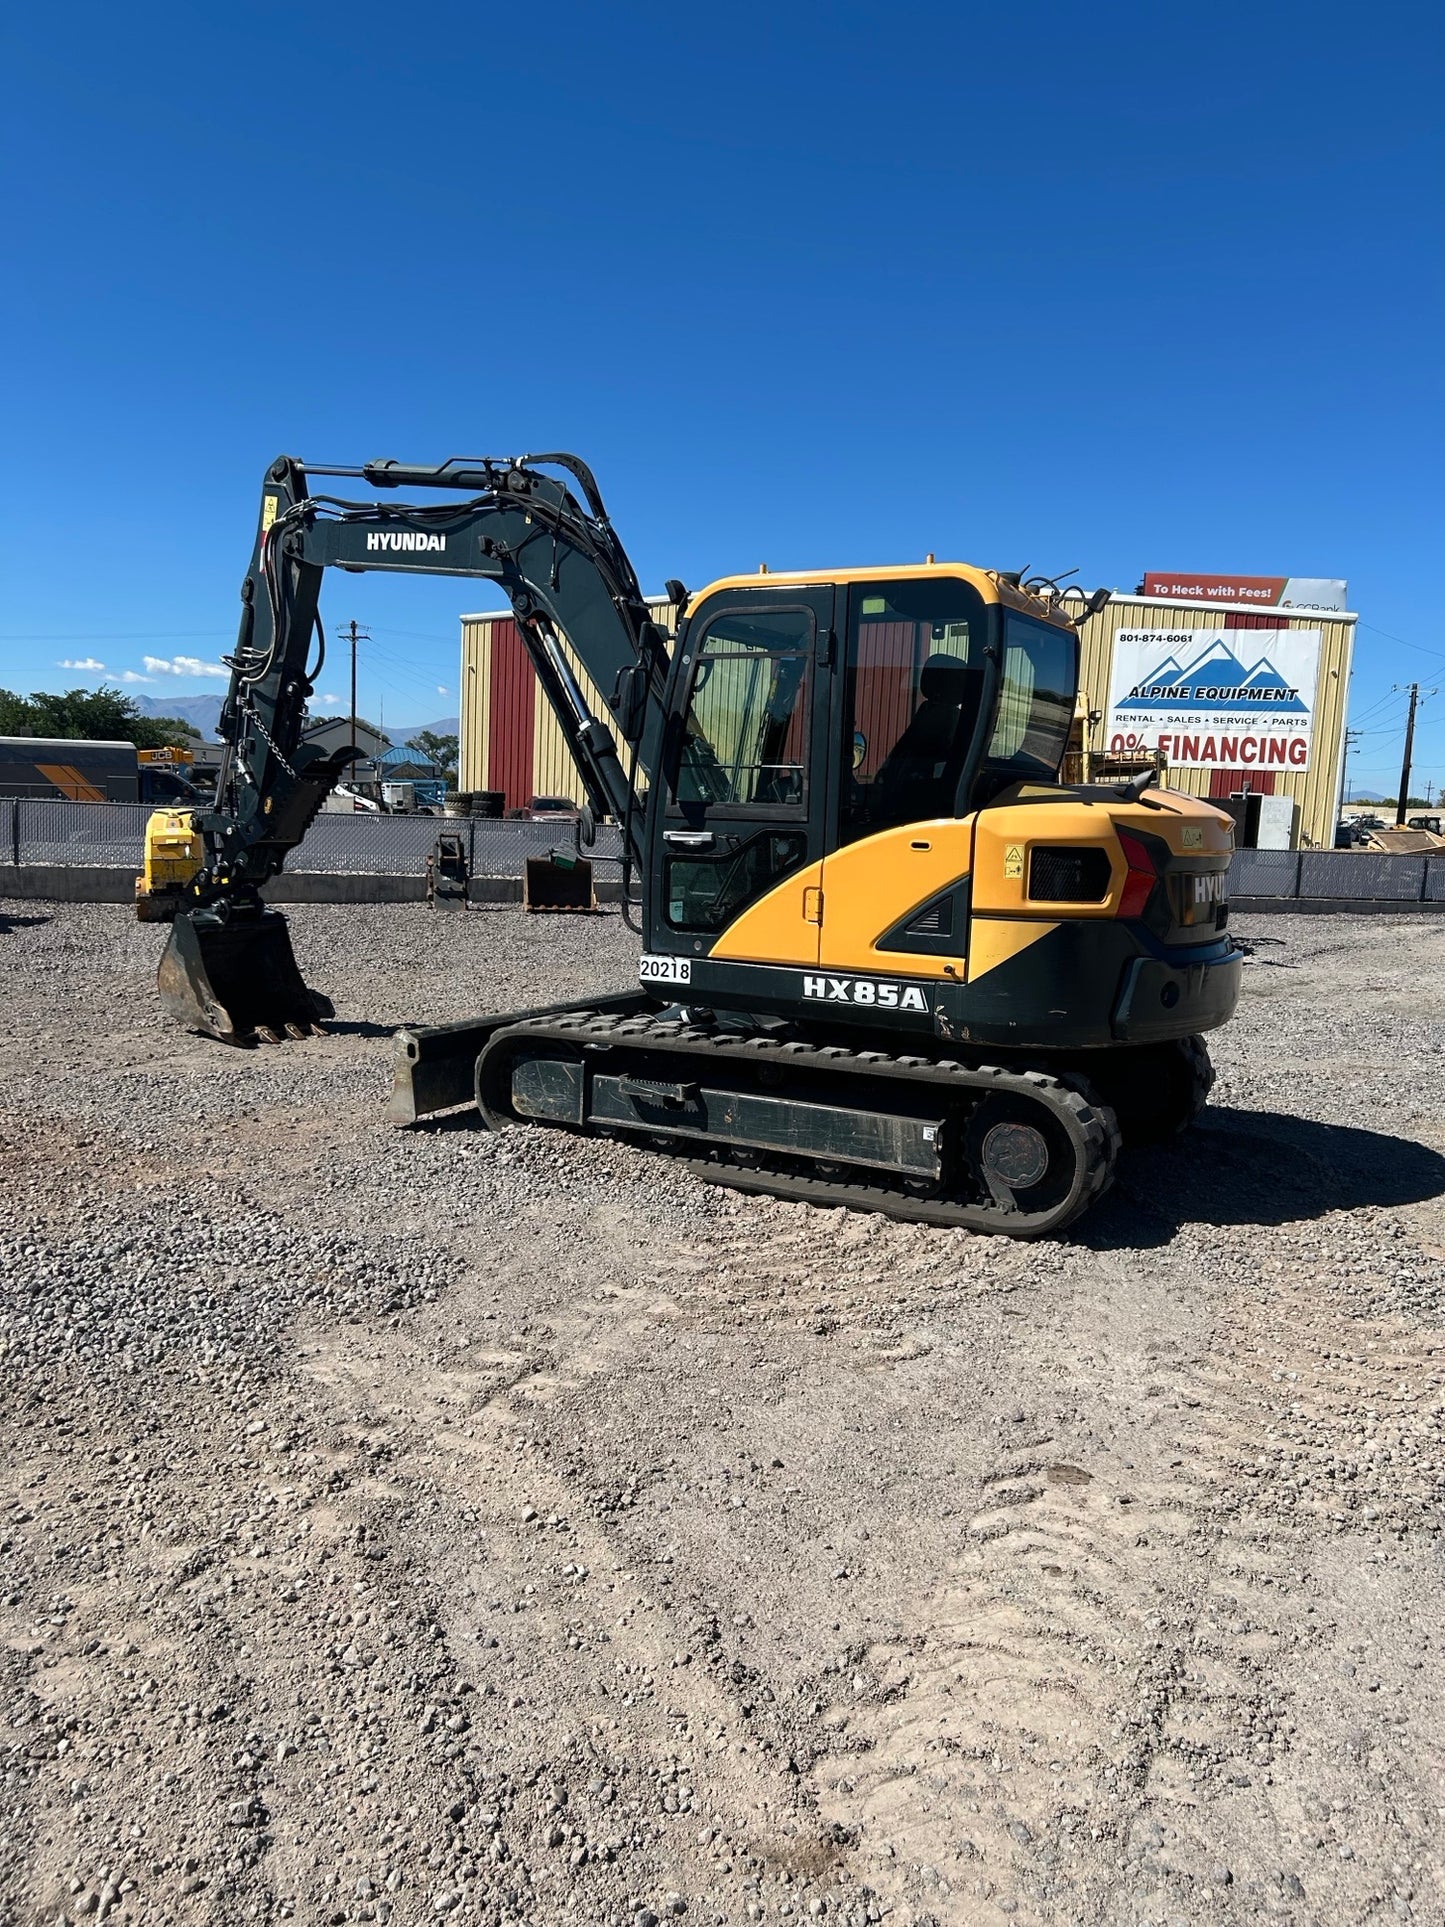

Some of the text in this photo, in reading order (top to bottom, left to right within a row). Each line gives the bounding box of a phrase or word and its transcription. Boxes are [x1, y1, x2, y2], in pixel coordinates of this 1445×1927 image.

[367, 533, 446, 551] HYUNDAI
[1153, 584, 1271, 598] To Heck with Fees!
[1119, 634, 1193, 643] 801-874-6061
[1128, 686, 1299, 701] ALPINE EQUIPMENT
[1115, 714, 1308, 727] RENTAL SALES SERVICE PARTS
[151, 751, 172, 760] JCB
[1158, 734, 1308, 765] FINANCING
[1194, 875, 1225, 904] HYU
[640, 960, 690, 980] 20218
[803, 975, 928, 1013] HX85A
